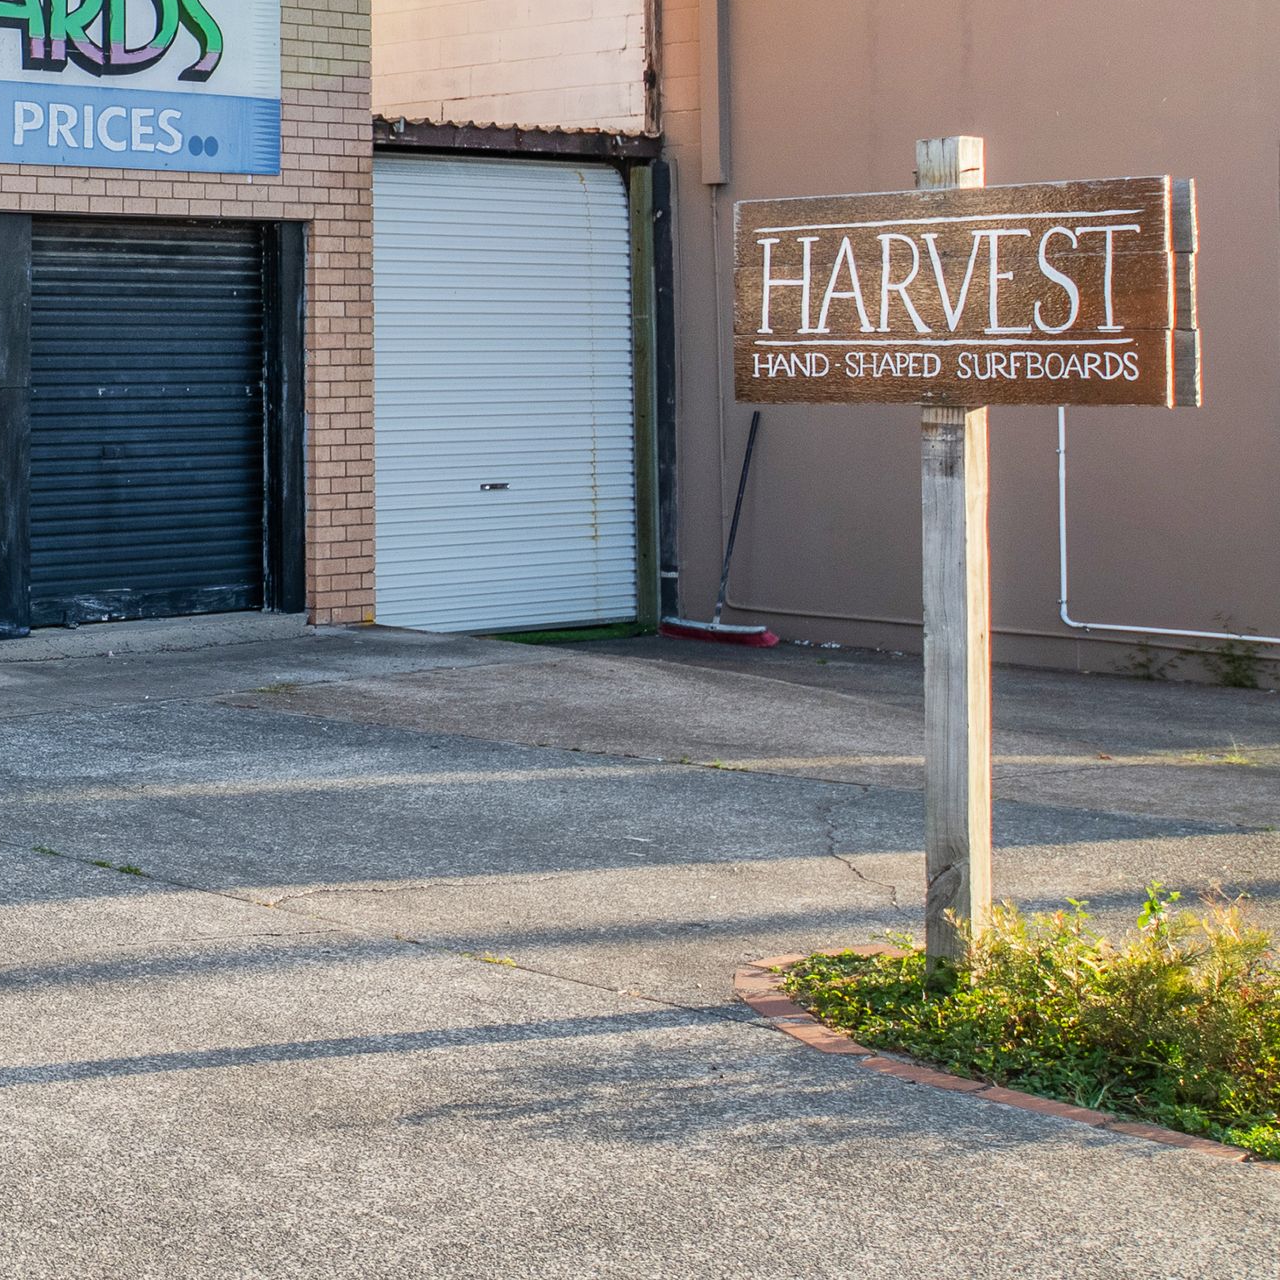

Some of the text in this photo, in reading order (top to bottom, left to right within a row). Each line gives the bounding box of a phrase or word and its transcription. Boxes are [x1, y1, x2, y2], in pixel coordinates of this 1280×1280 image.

[13, 99, 184, 154] PRICES
[756, 224, 1141, 336] HARVEST
[957, 350, 1139, 381] SURFBOARDS
